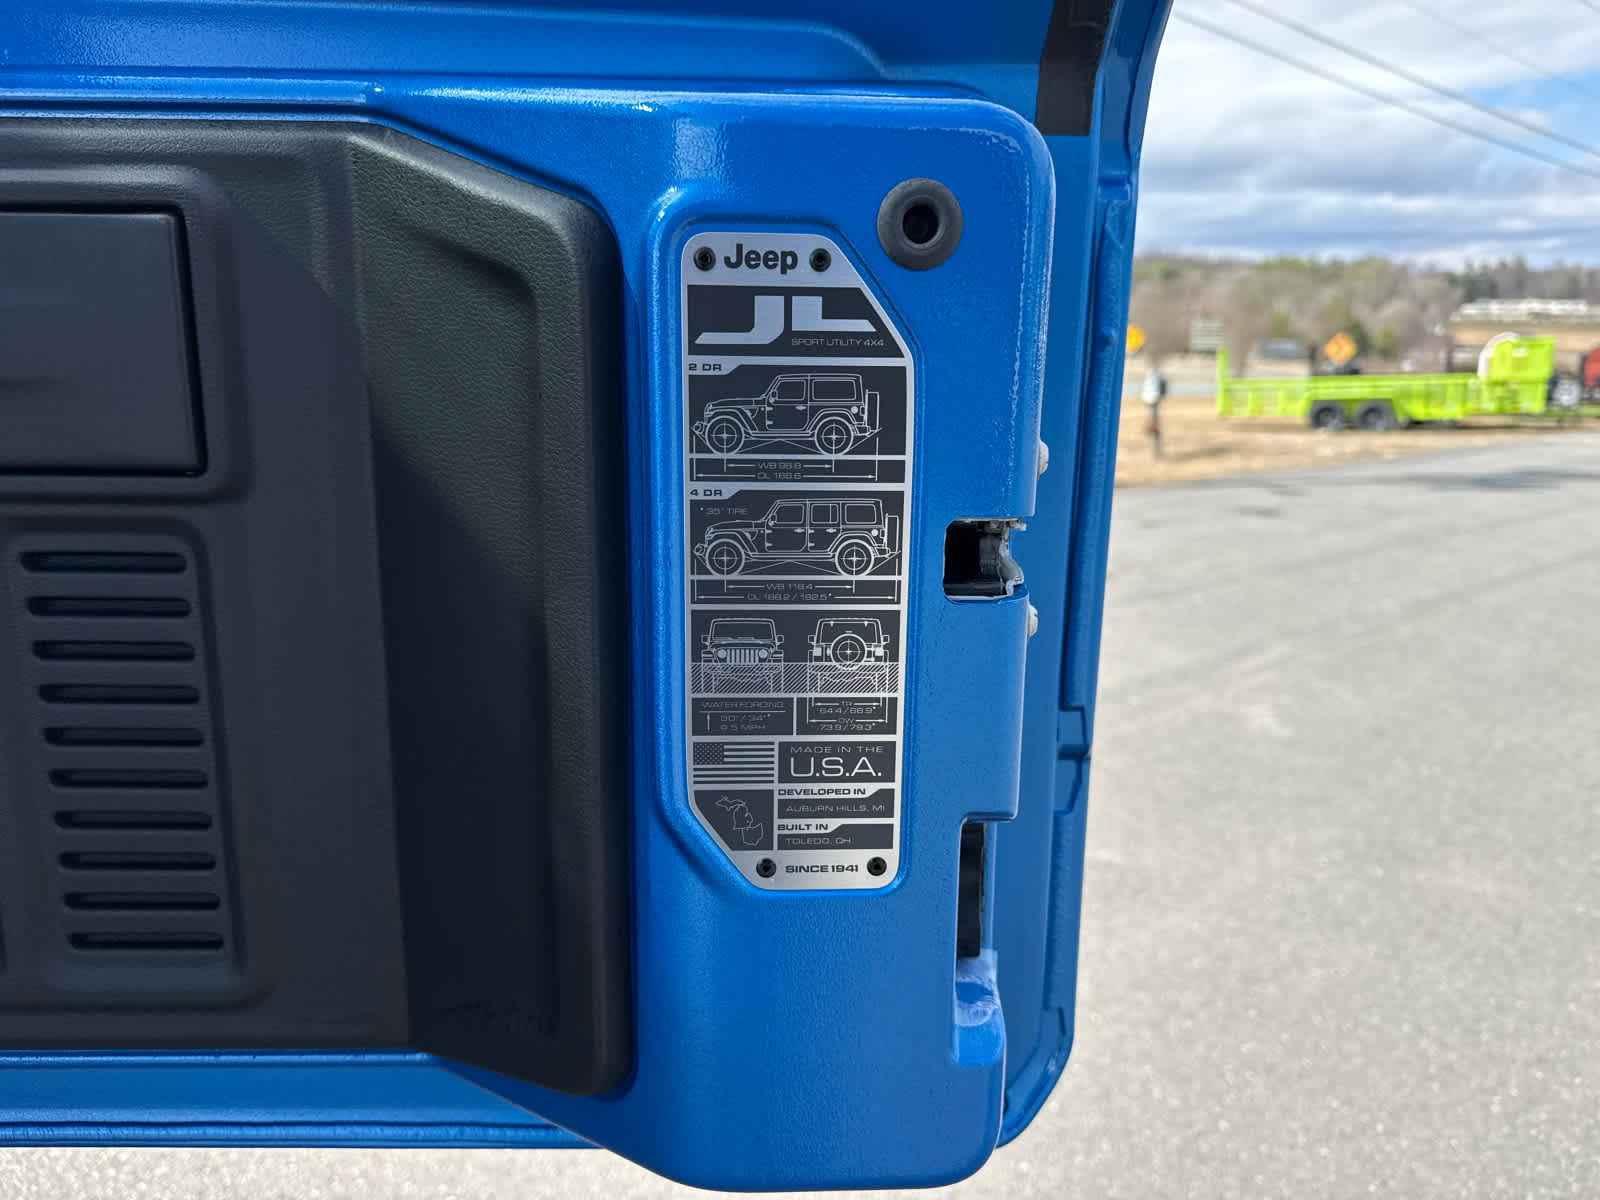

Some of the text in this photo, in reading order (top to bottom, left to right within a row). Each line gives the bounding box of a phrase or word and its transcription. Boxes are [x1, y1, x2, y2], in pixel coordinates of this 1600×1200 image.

[724, 243, 798, 275] Jeep
[695, 295, 877, 345] JL
[791, 338, 885, 347] SPORT UTILITY 4X4
[688, 363, 722, 371] 2 DR
[790, 746, 832, 754] MADE
[856, 745, 885, 753] THE
[790, 756, 882, 777] U.S.A.
[778, 788, 851, 796] DEVELOPED
[786, 804, 833, 812] AUBURN
[872, 804, 885, 812] MI
[777, 823, 829, 831] BUILT IN
[785, 865, 858, 873] SINCE 1941
